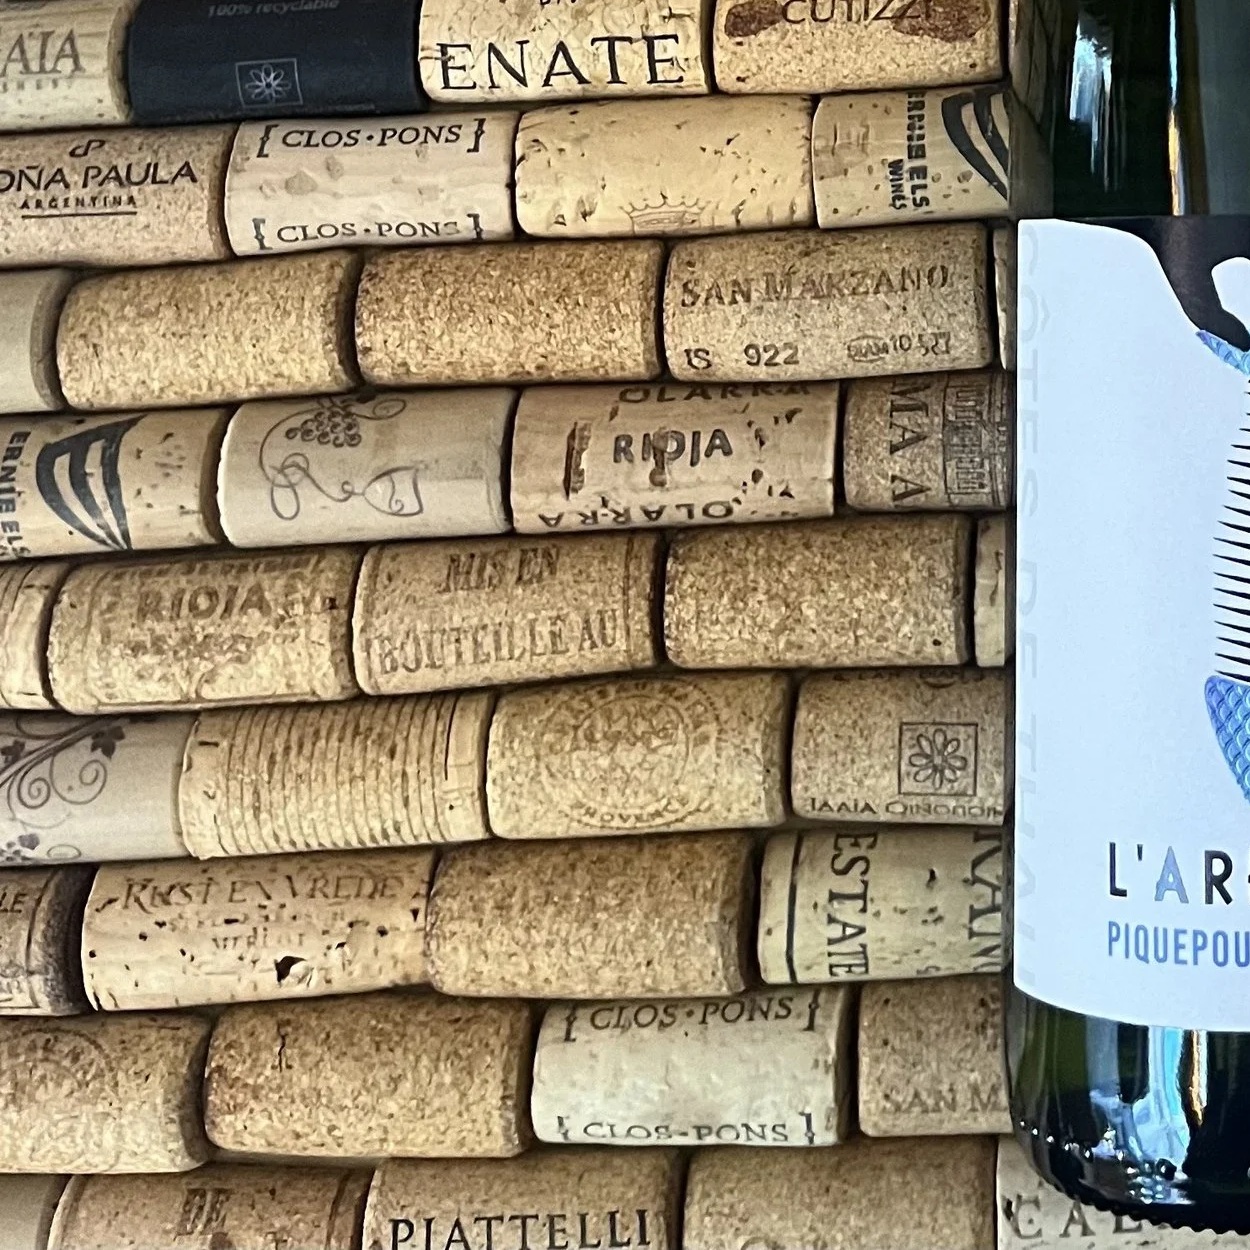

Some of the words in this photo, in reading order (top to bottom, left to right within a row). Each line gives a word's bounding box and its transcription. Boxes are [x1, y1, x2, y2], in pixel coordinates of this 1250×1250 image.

[435, 32, 685, 92] ENATE
[82, 160, 198, 189] PAULA
[763, 263, 949, 303] MARZANO
